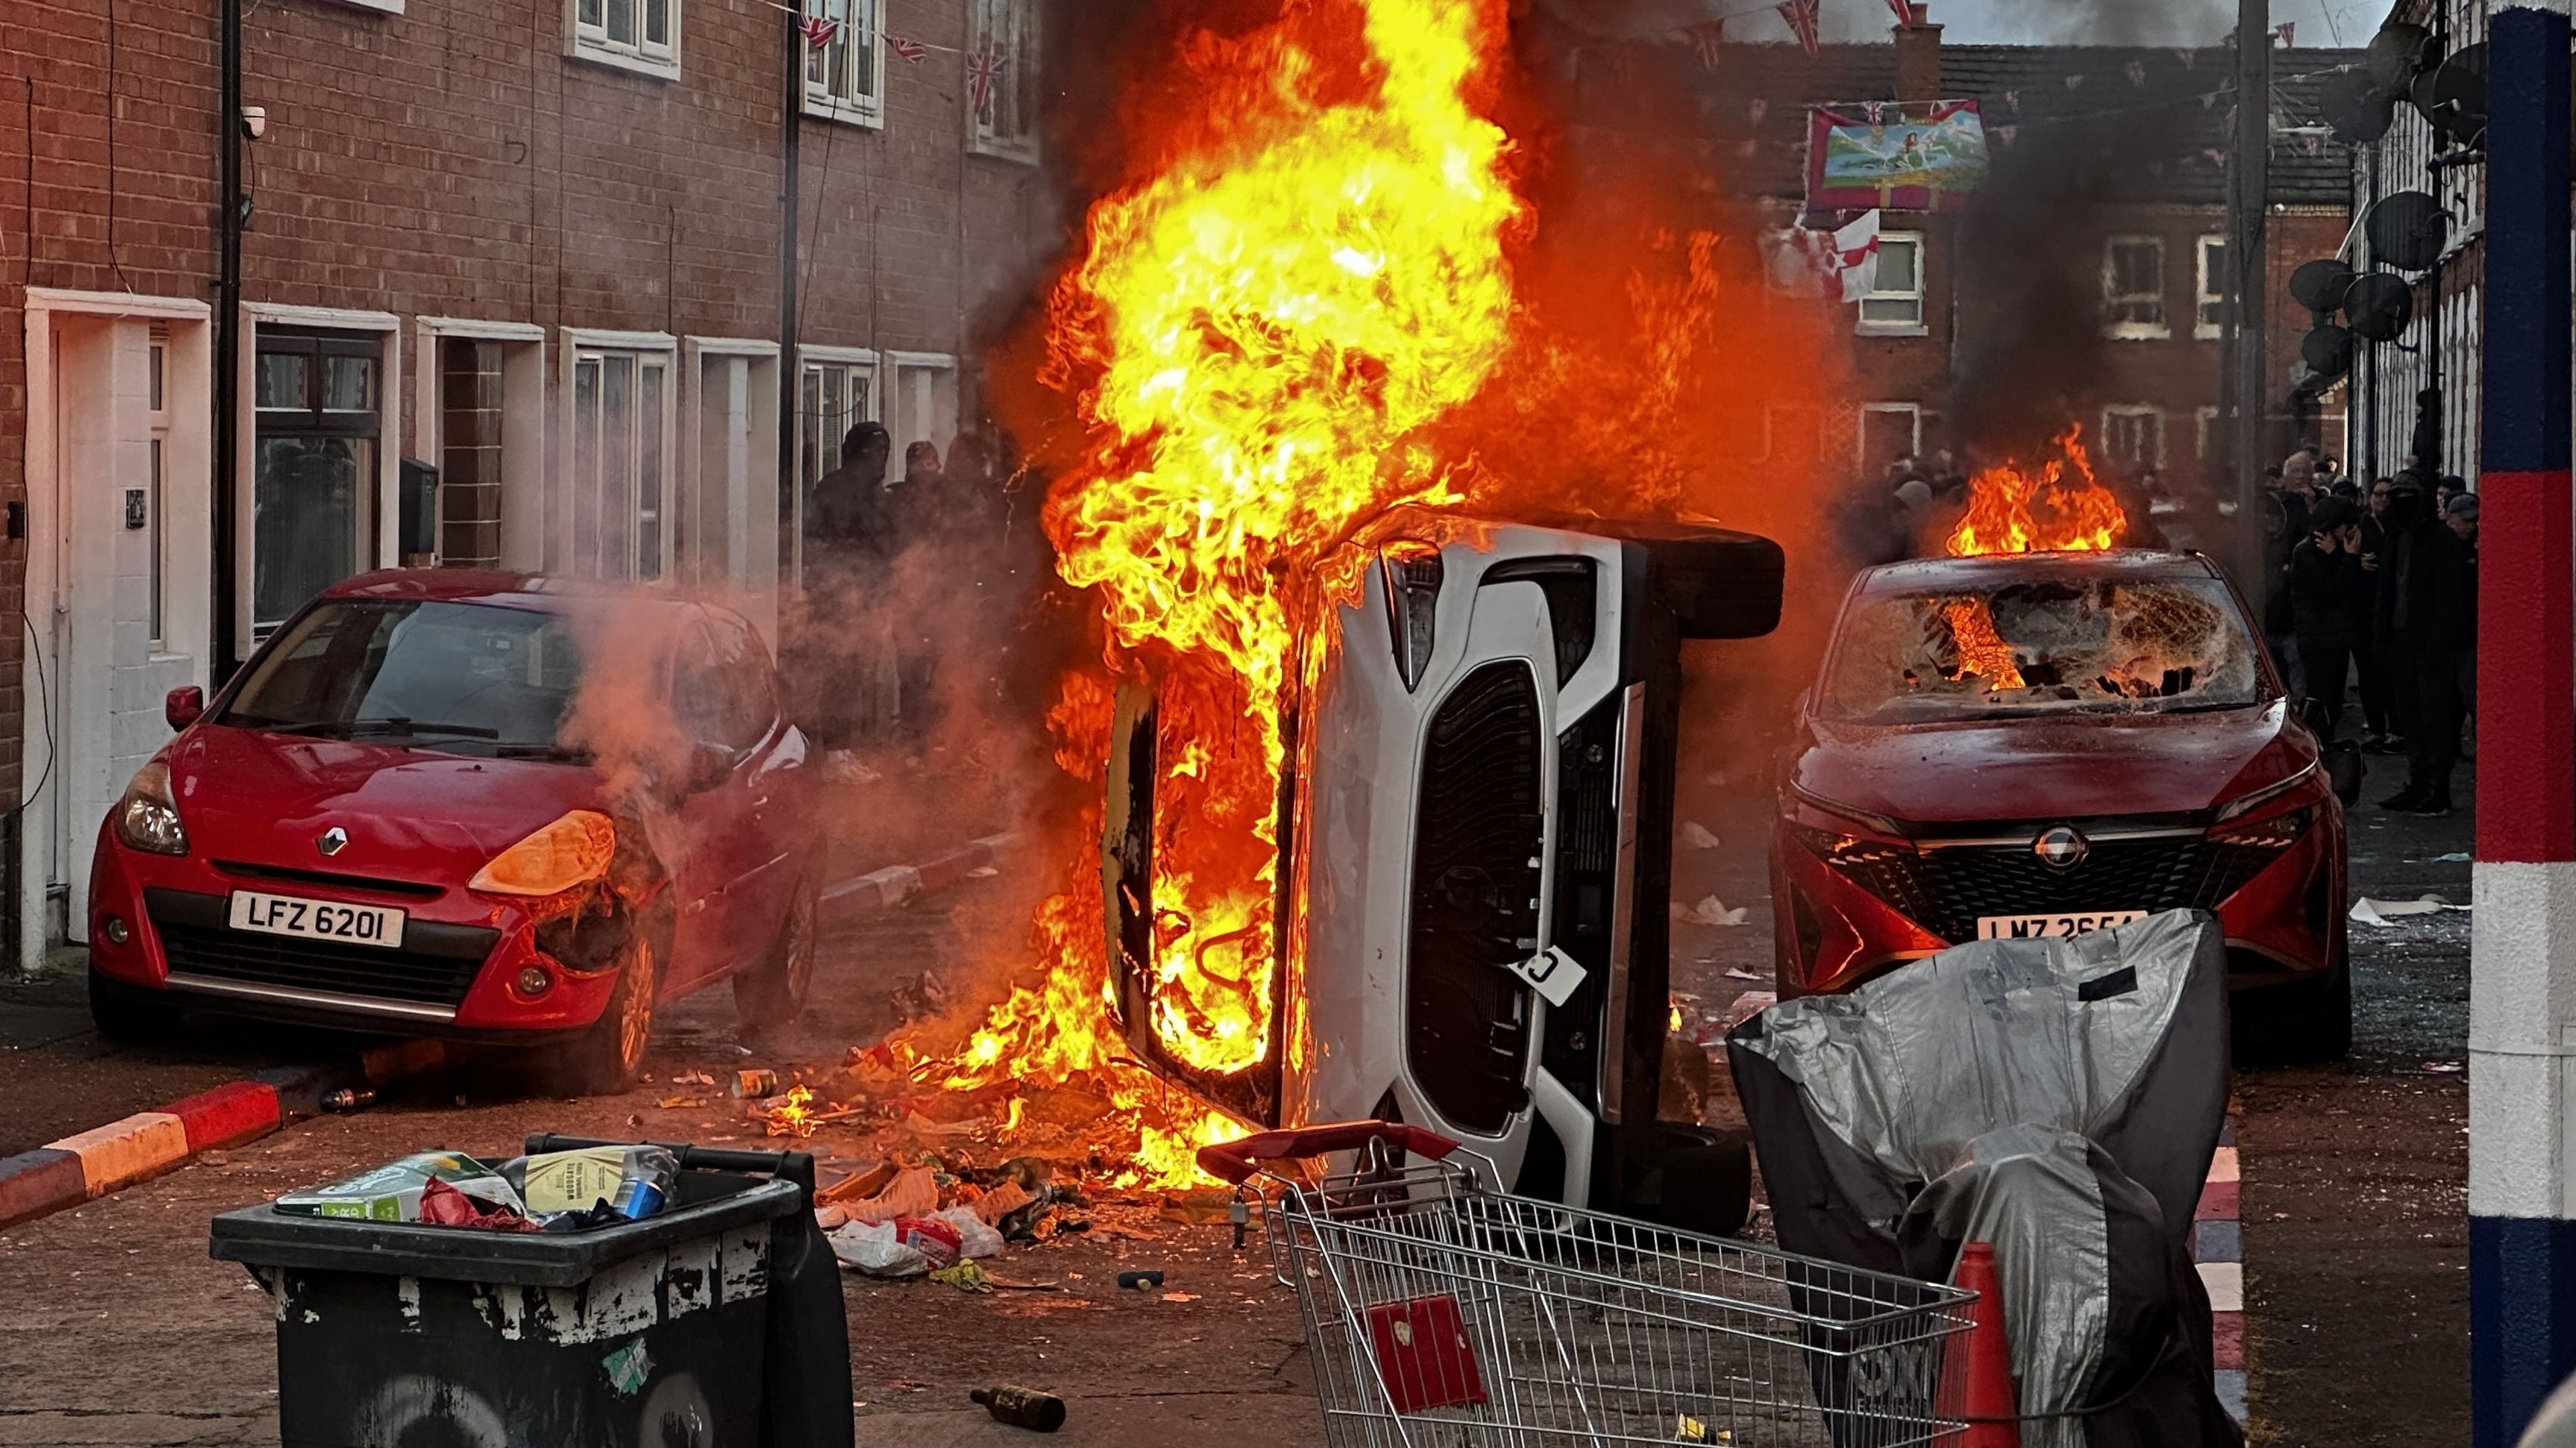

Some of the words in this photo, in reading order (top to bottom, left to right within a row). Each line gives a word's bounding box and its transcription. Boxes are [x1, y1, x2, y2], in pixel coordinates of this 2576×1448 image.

[249, 897, 307, 931] LFZ
[315, 906, 384, 940] 6201
[566, 1162, 575, 1201] WOODGATE
